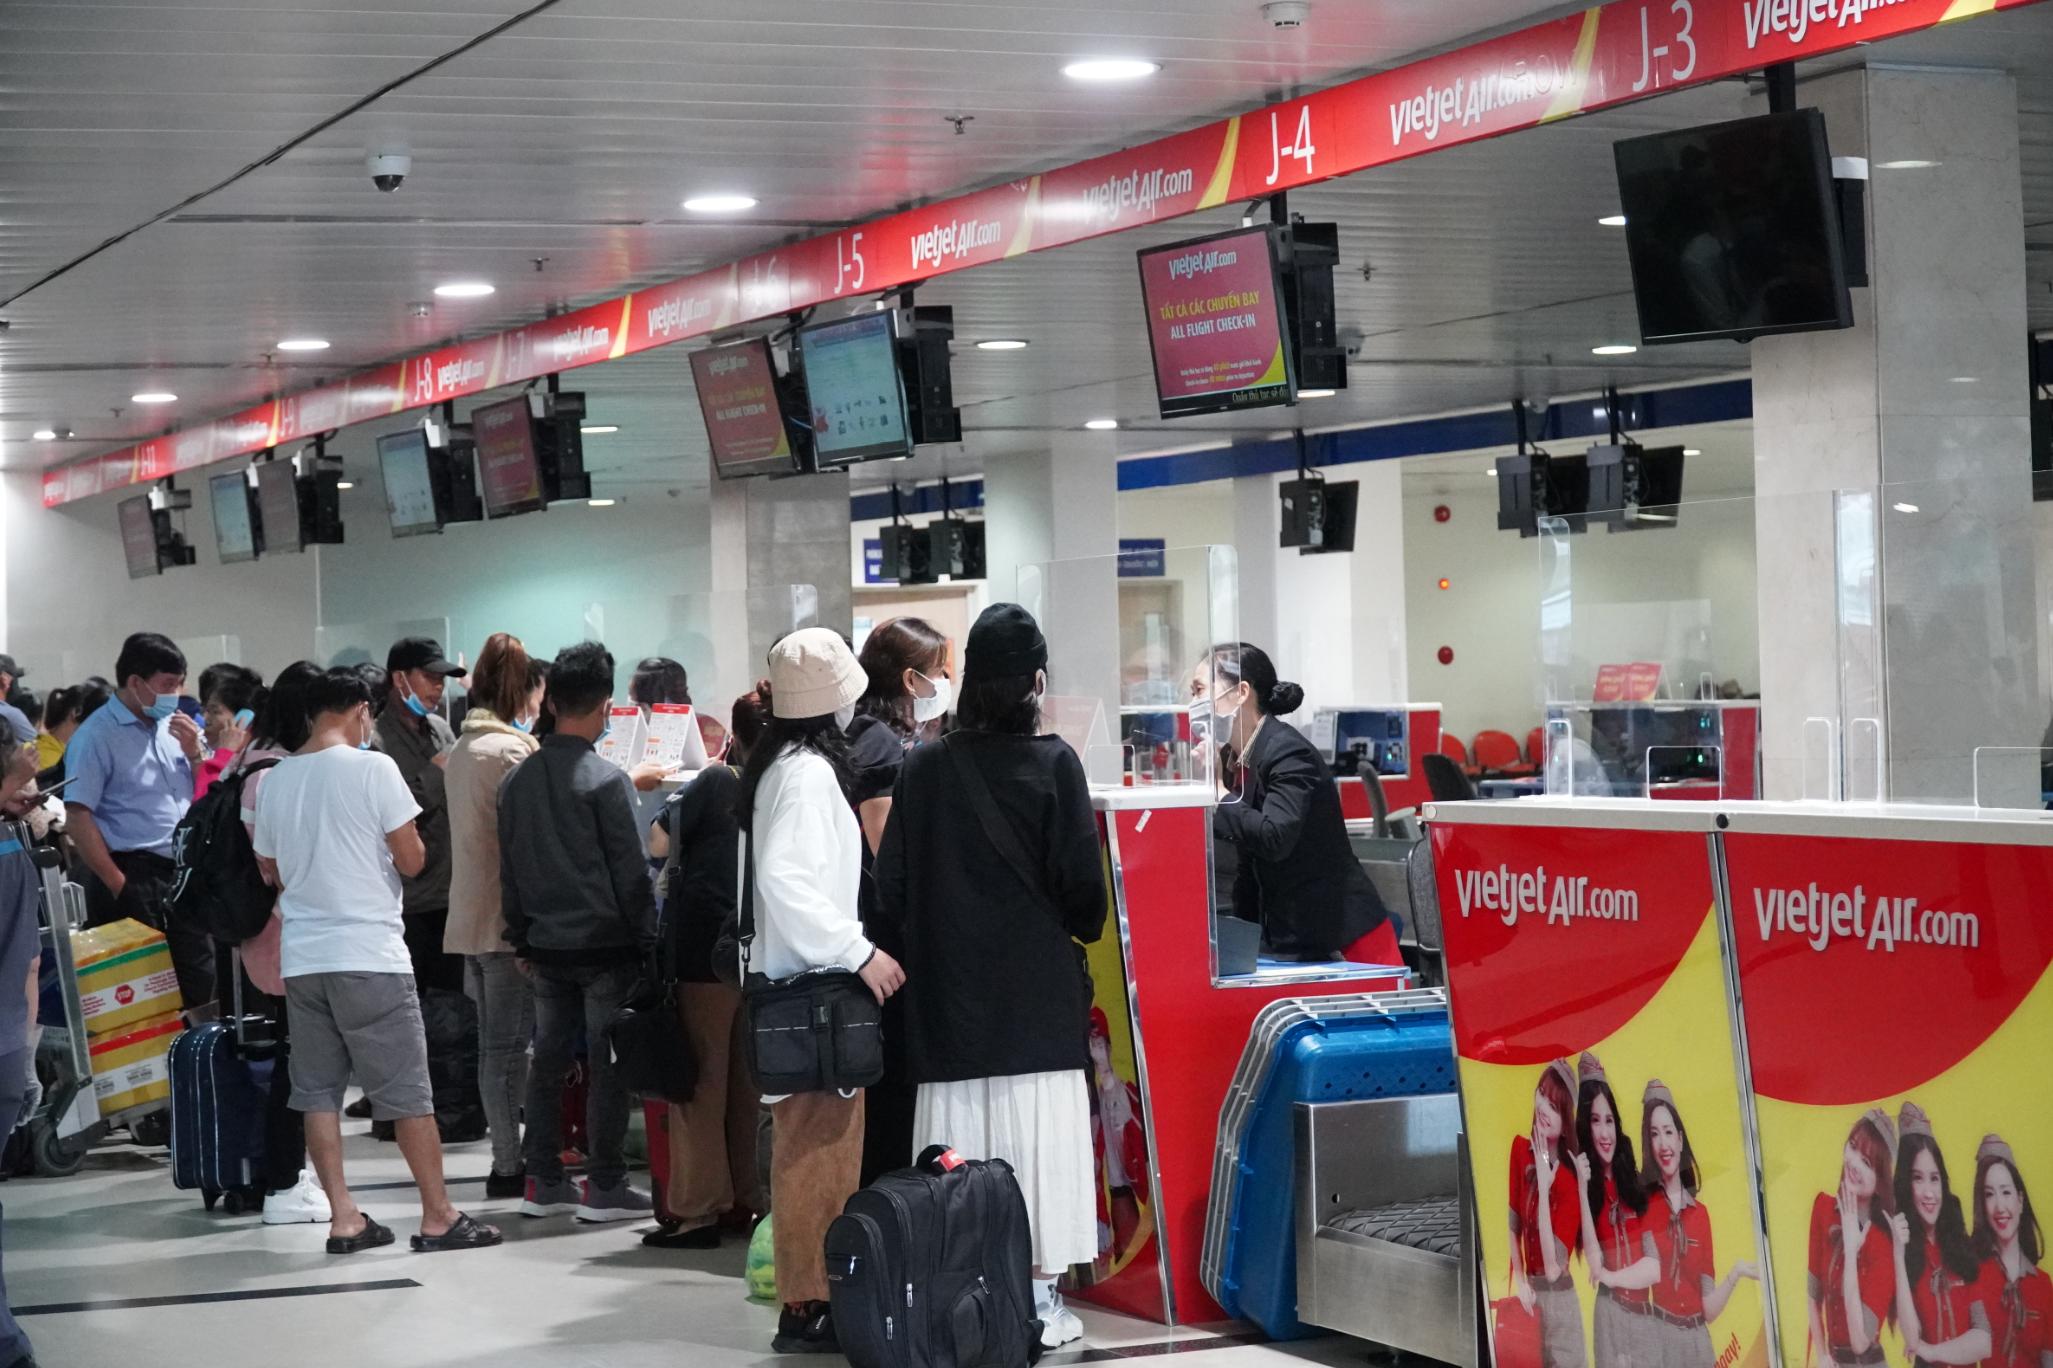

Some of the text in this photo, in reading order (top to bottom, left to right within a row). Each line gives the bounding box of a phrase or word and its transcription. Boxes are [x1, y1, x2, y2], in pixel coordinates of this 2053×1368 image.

[1632, 0, 1696, 92] J-3
[1266, 104, 1316, 186] J-4
[834, 232, 864, 294] J-5
[1170, 324, 1186, 340] ALL
[1187, 319, 1214, 336] FLIGHT
[414, 356, 433, 402] J-8
